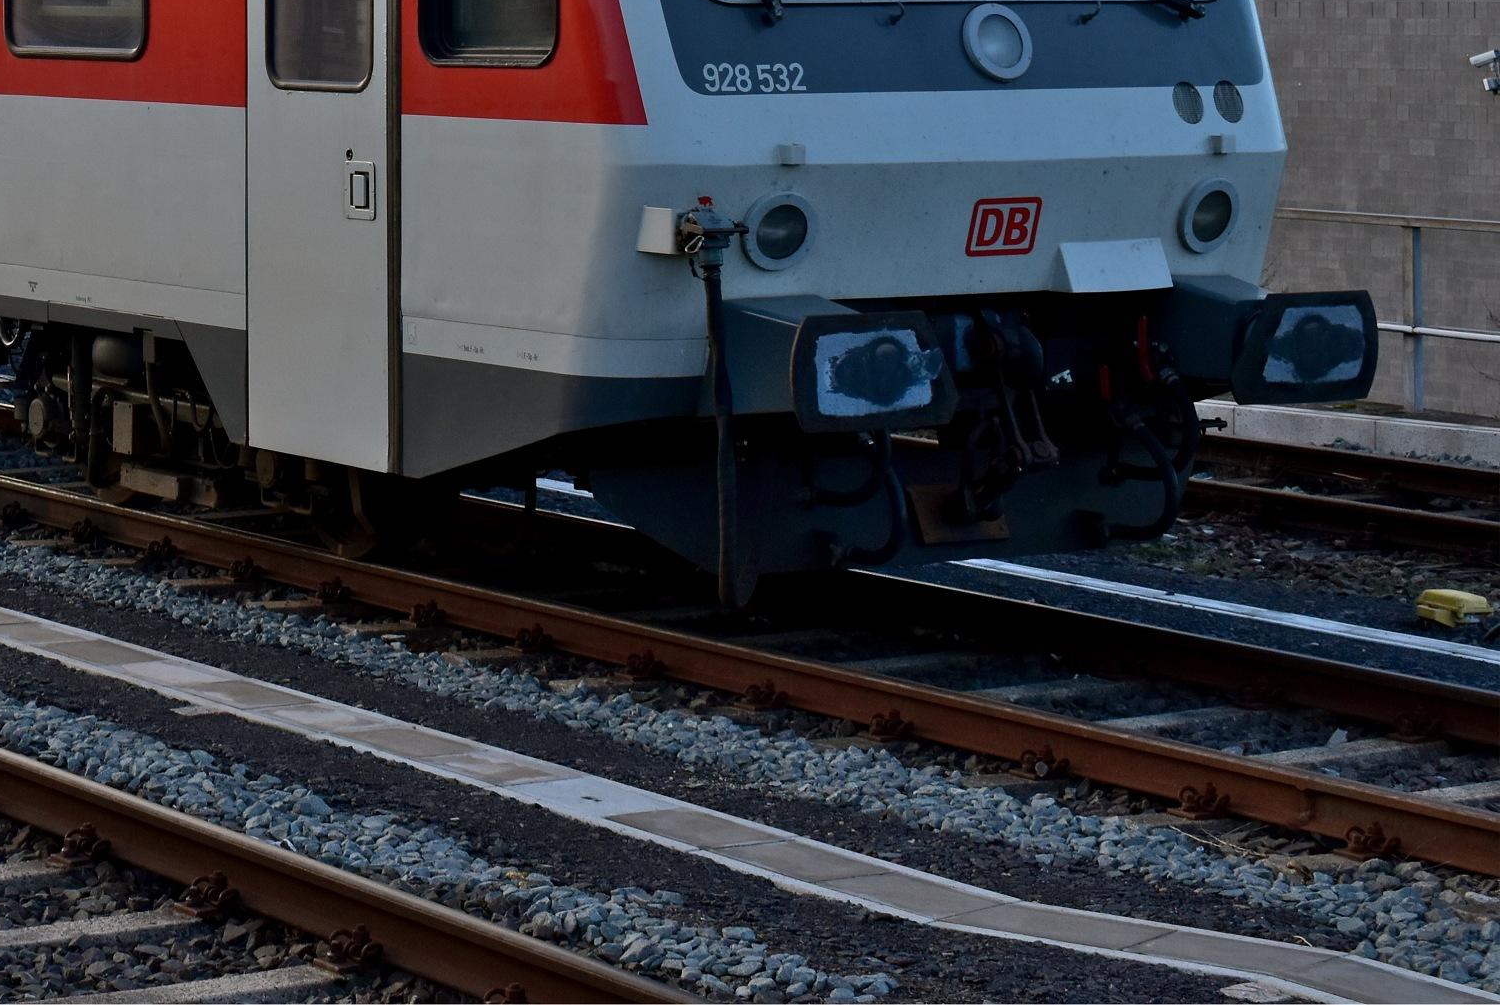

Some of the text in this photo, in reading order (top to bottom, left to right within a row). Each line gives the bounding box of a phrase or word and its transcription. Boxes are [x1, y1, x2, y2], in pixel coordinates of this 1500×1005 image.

[702, 62, 808, 93] 928 532
[975, 206, 1031, 247] DB
